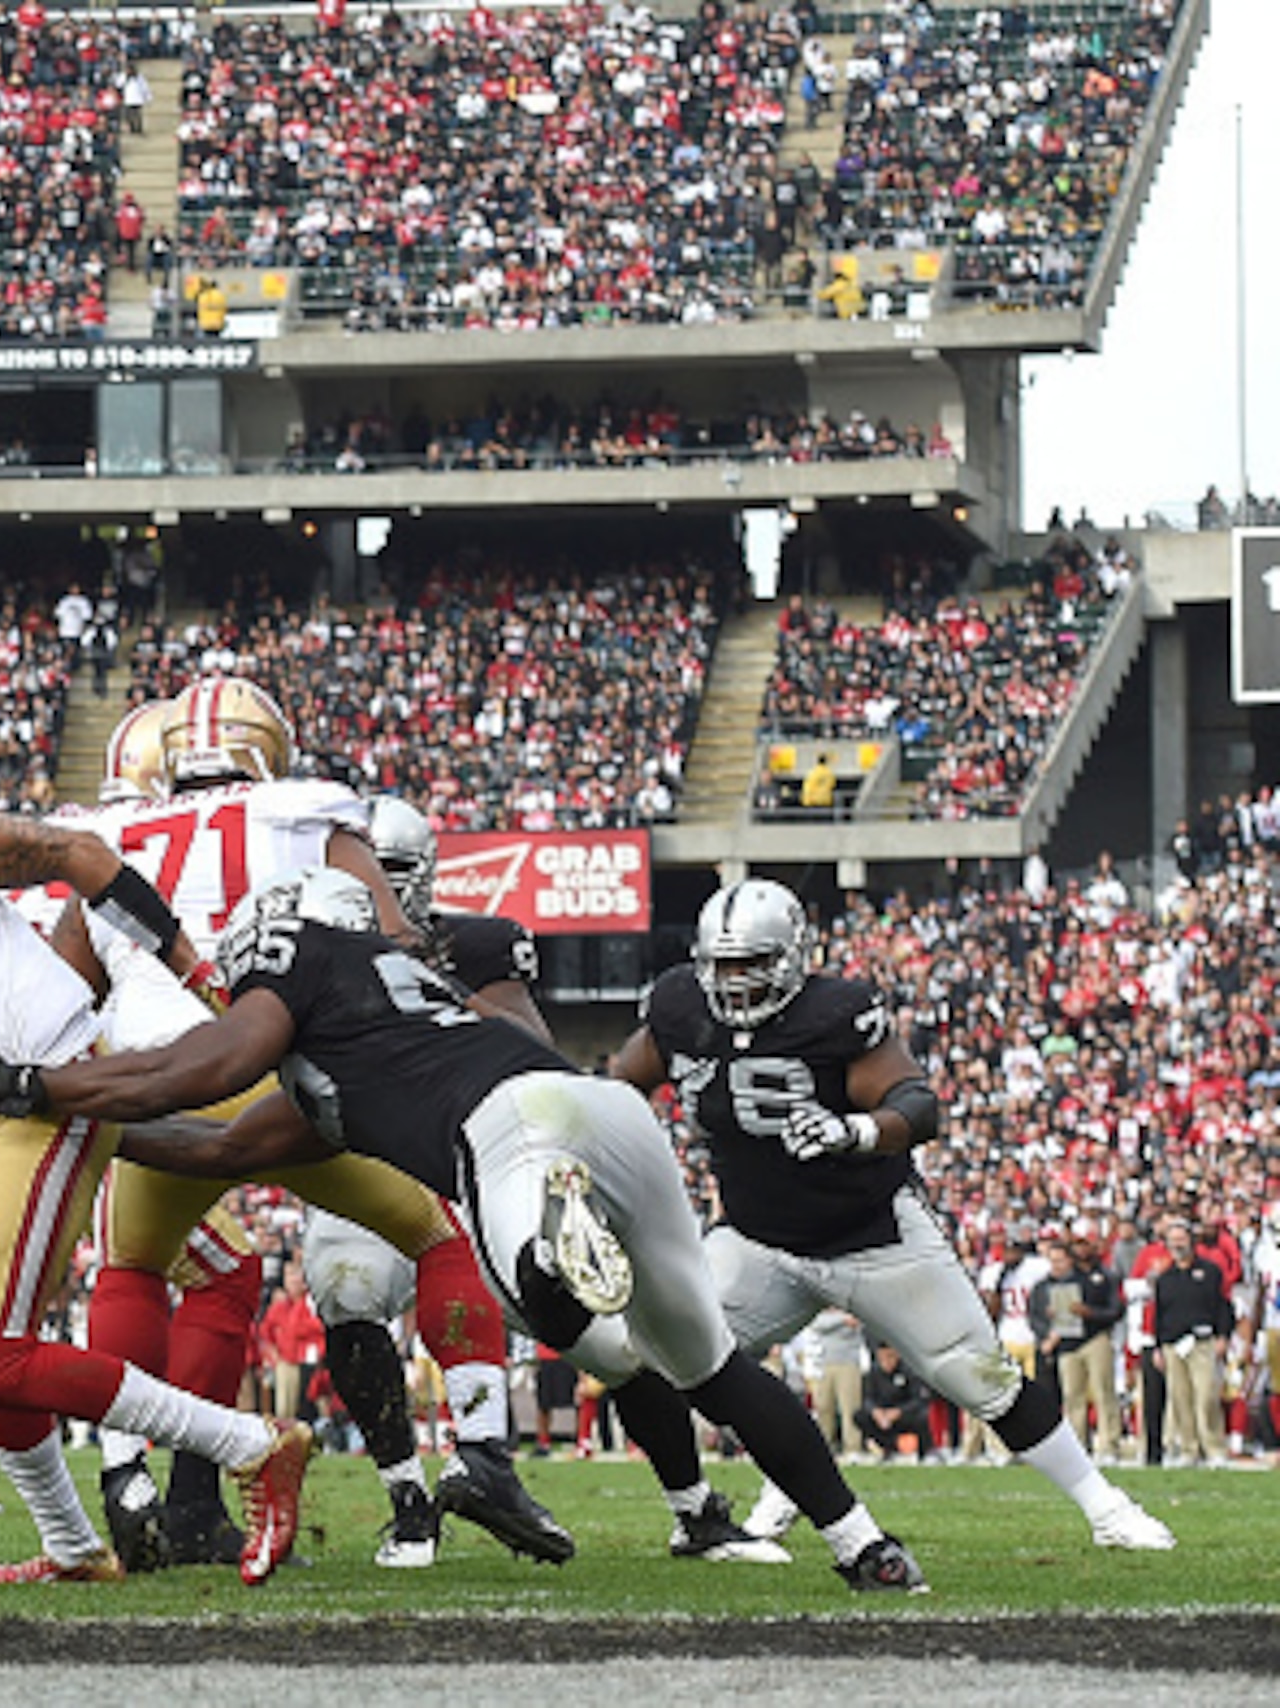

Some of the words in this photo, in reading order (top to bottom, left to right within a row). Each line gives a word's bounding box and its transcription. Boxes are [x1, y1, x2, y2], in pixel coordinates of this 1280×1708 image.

[60, 347, 88, 371] TO
[119, 800, 250, 933] 71
[535, 844, 641, 874] GRAB
[552, 873, 624, 889] SOME
[535, 888, 640, 918] BUDS
